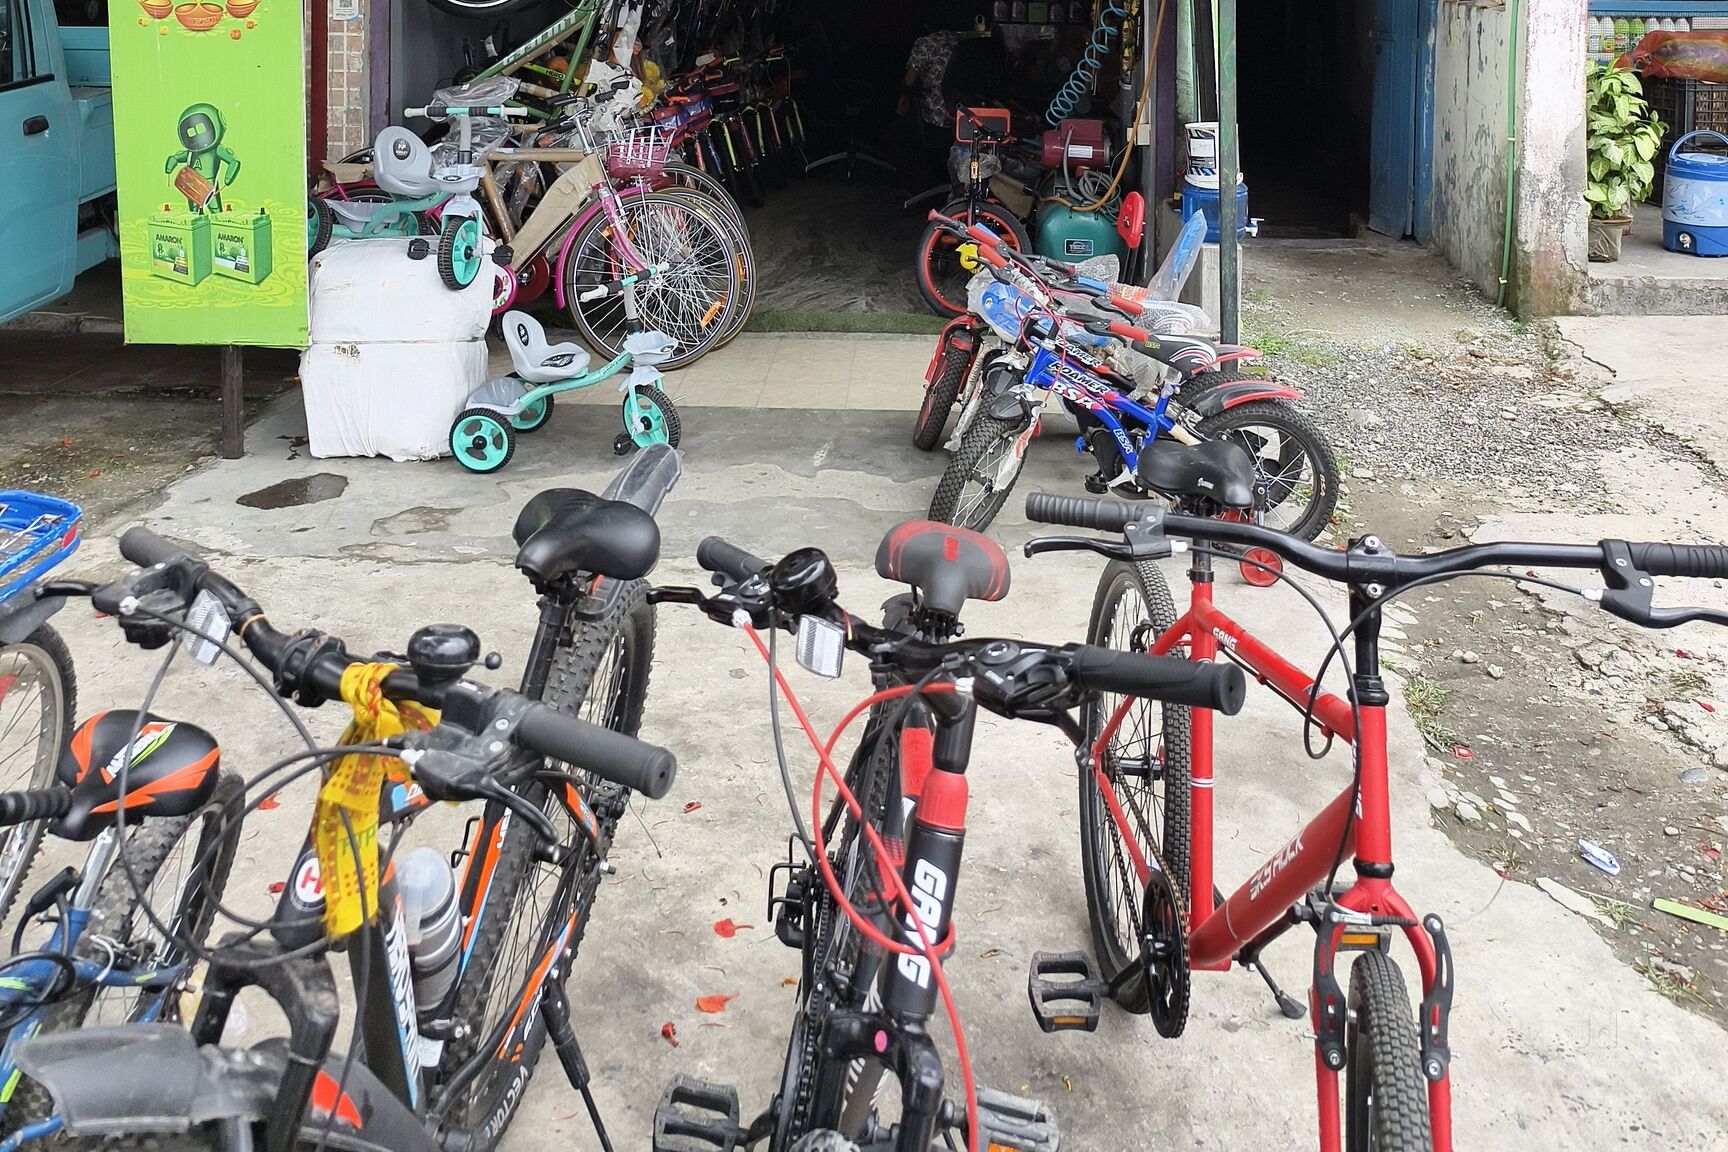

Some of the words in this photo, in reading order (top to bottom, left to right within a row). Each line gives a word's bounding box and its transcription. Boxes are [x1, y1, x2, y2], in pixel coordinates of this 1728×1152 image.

[546, 69, 564, 79] HERO
[1048, 360, 1112, 395] ROAMER
[1052, 380, 1094, 410] BSA
[1114, 428, 1135, 455] BSA
[1213, 626, 1238, 651] GANG
[490, 1064, 529, 1138] VECTOR
